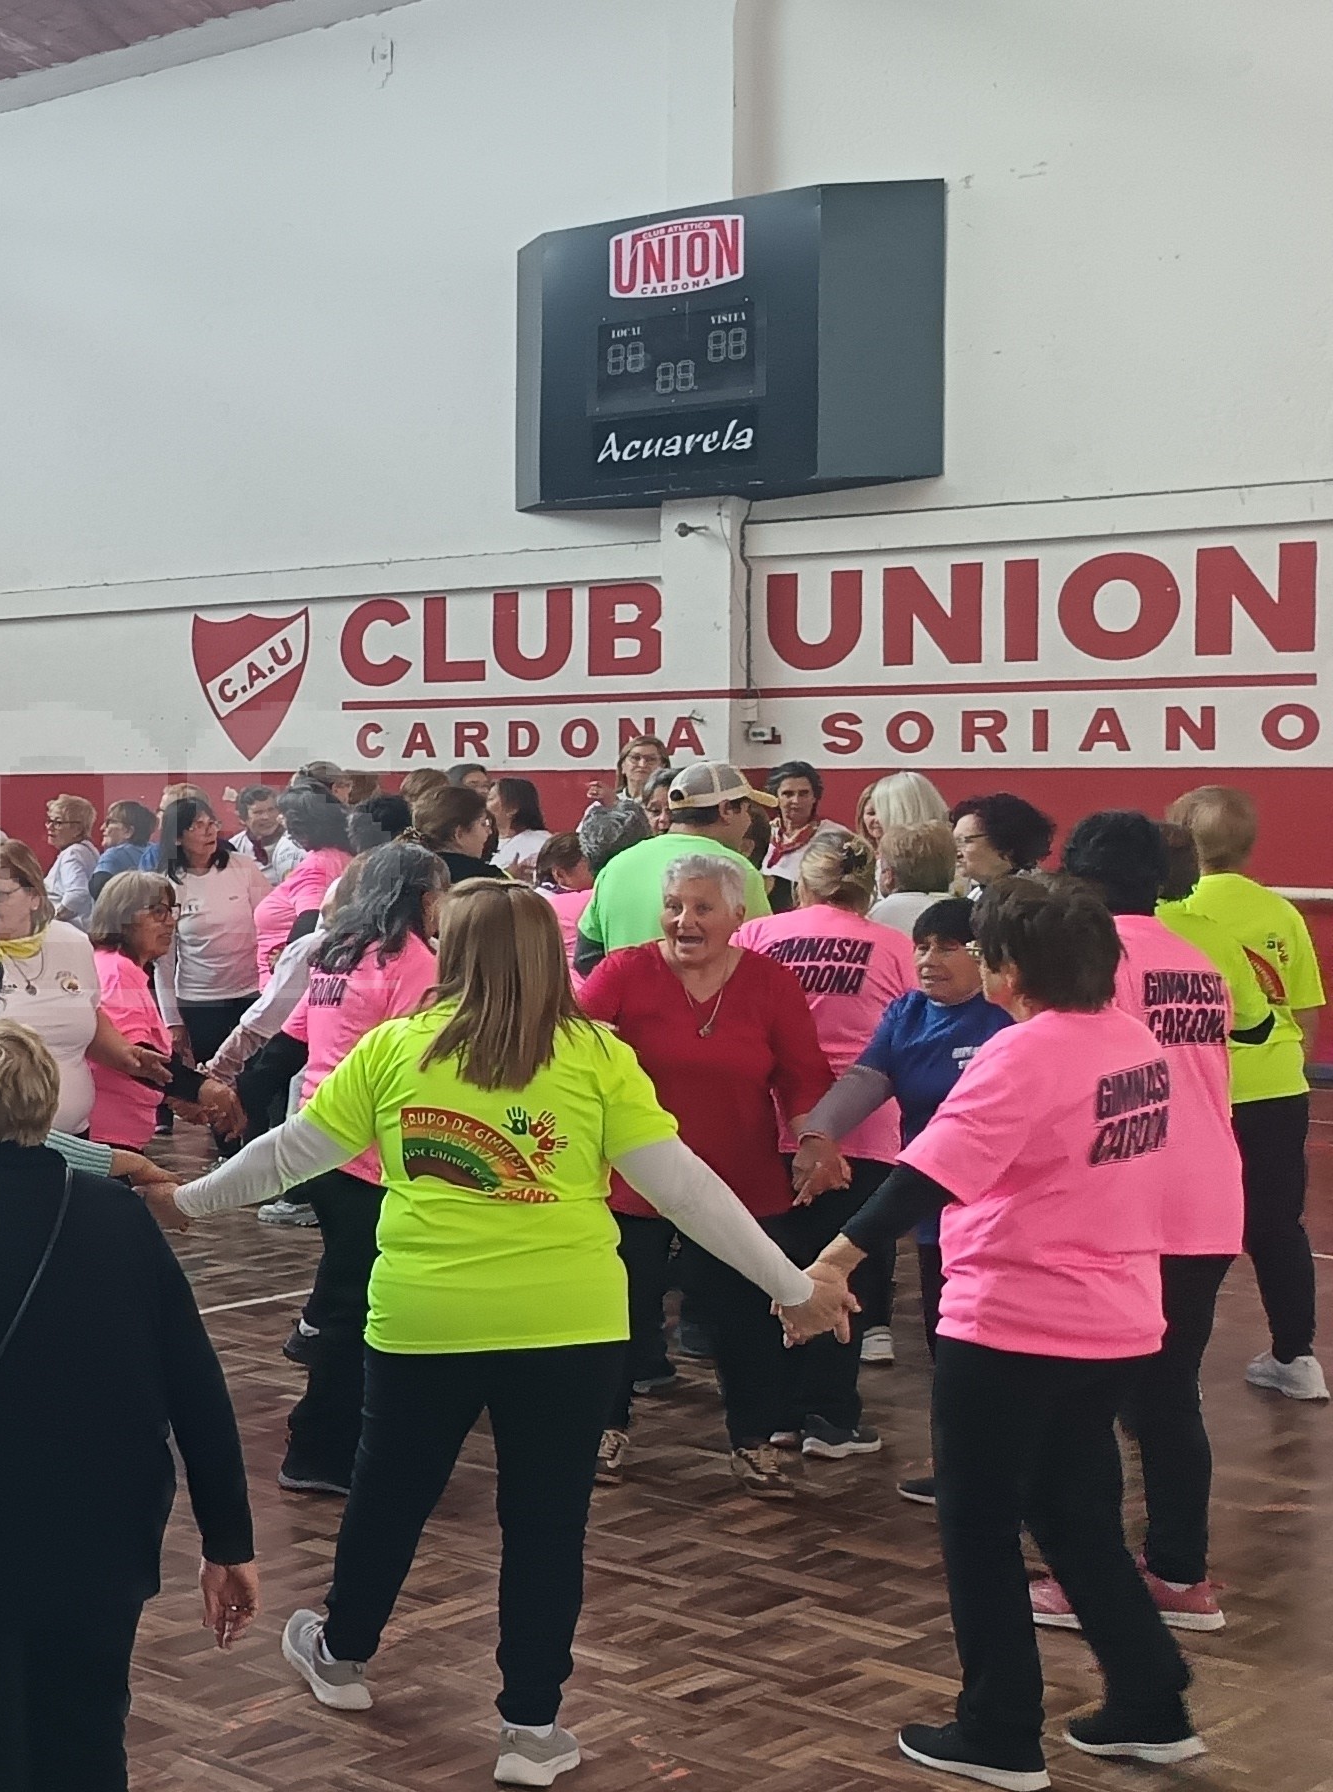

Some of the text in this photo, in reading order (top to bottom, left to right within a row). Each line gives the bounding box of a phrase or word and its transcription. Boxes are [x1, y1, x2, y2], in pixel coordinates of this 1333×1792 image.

[641, 221, 711, 240] CLUB ATLETICO
[614, 218, 740, 294] UNION
[640, 278, 711, 295] CARDONA
[710, 311, 746, 324] VISITA
[611, 326, 641, 339] LOCAL
[597, 419, 754, 463] Acuarela
[340, 541, 1318, 687] CLUB UNION
[355, 703, 1321, 759] CARDONA SORIANO
[764, 937, 873, 965] GIMNASIA
[781, 964, 866, 995] RDONA
[1096, 1060, 1169, 1119] GIMNAS
[401, 1111, 447, 1129] GRUPO
[451, 1118, 472, 1134] DE
